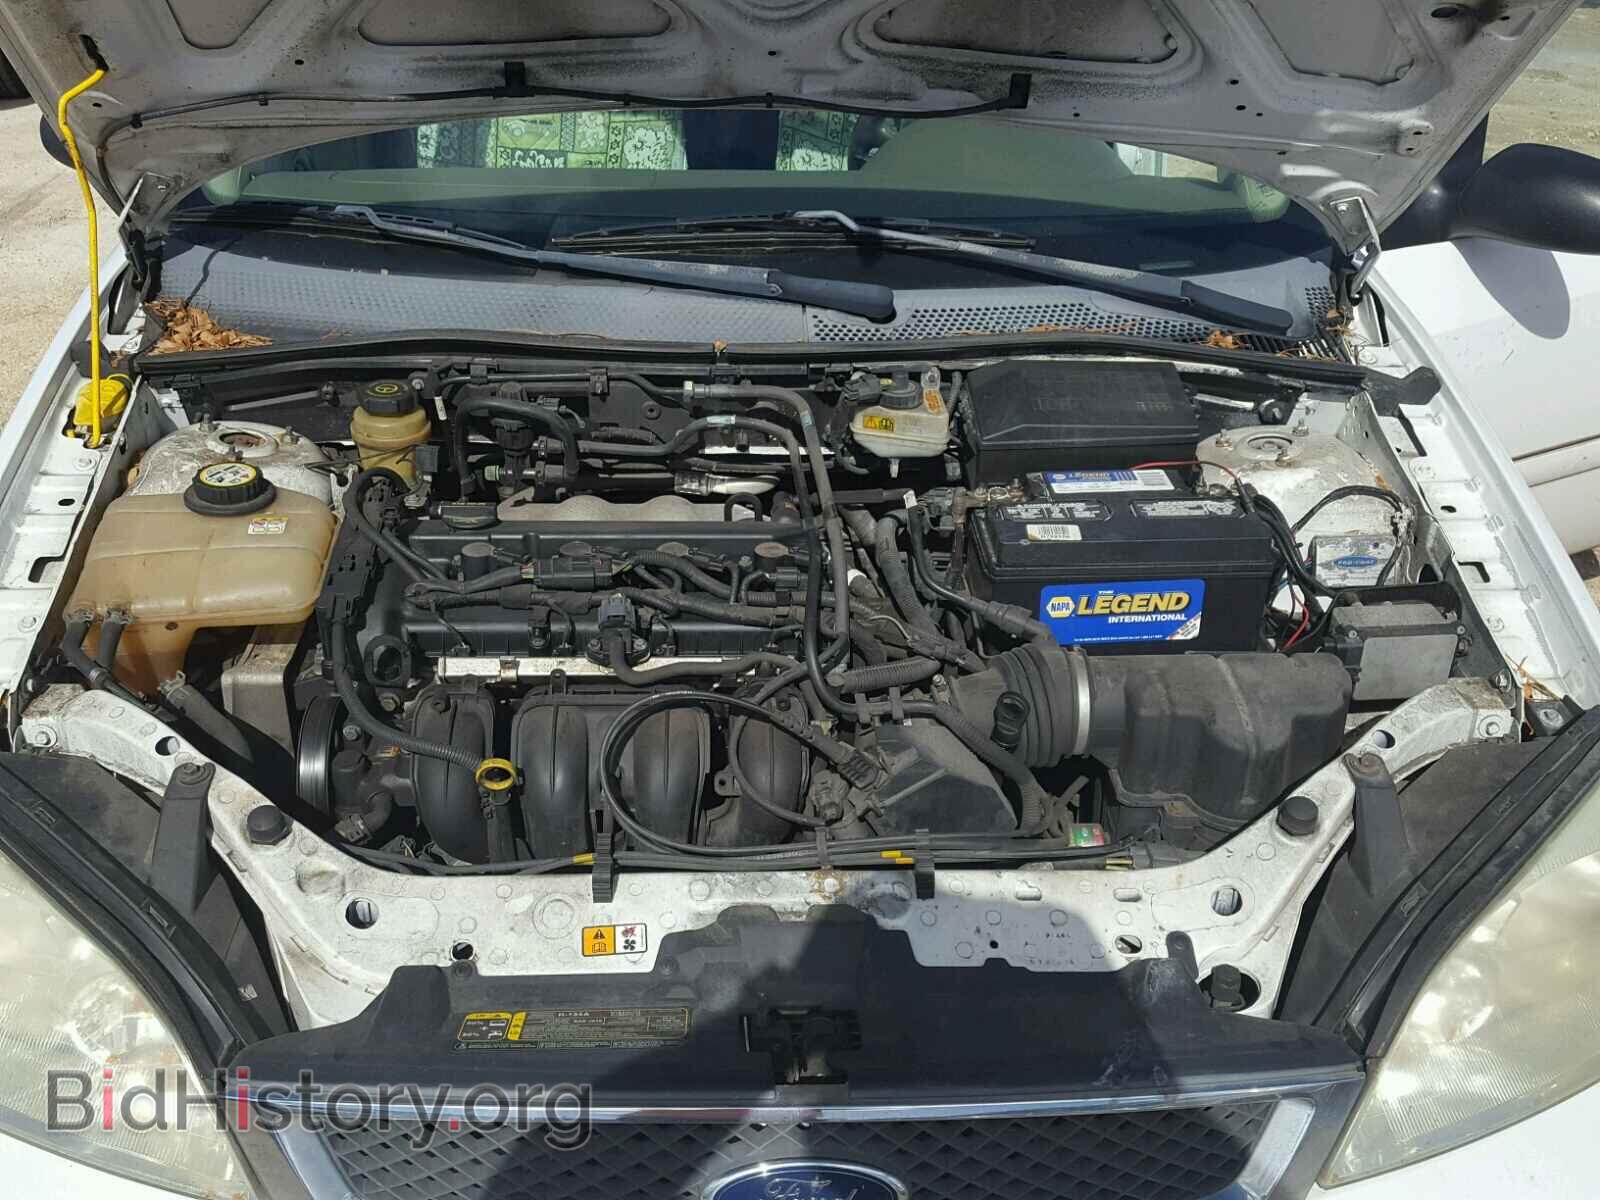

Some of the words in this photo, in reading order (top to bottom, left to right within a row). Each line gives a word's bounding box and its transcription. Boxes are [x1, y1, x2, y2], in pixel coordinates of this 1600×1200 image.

[1050, 602, 1072, 613] NAPA
[1077, 591, 1190, 615] LEGEND
[1107, 613, 1187, 624] INTERNATIONAL
